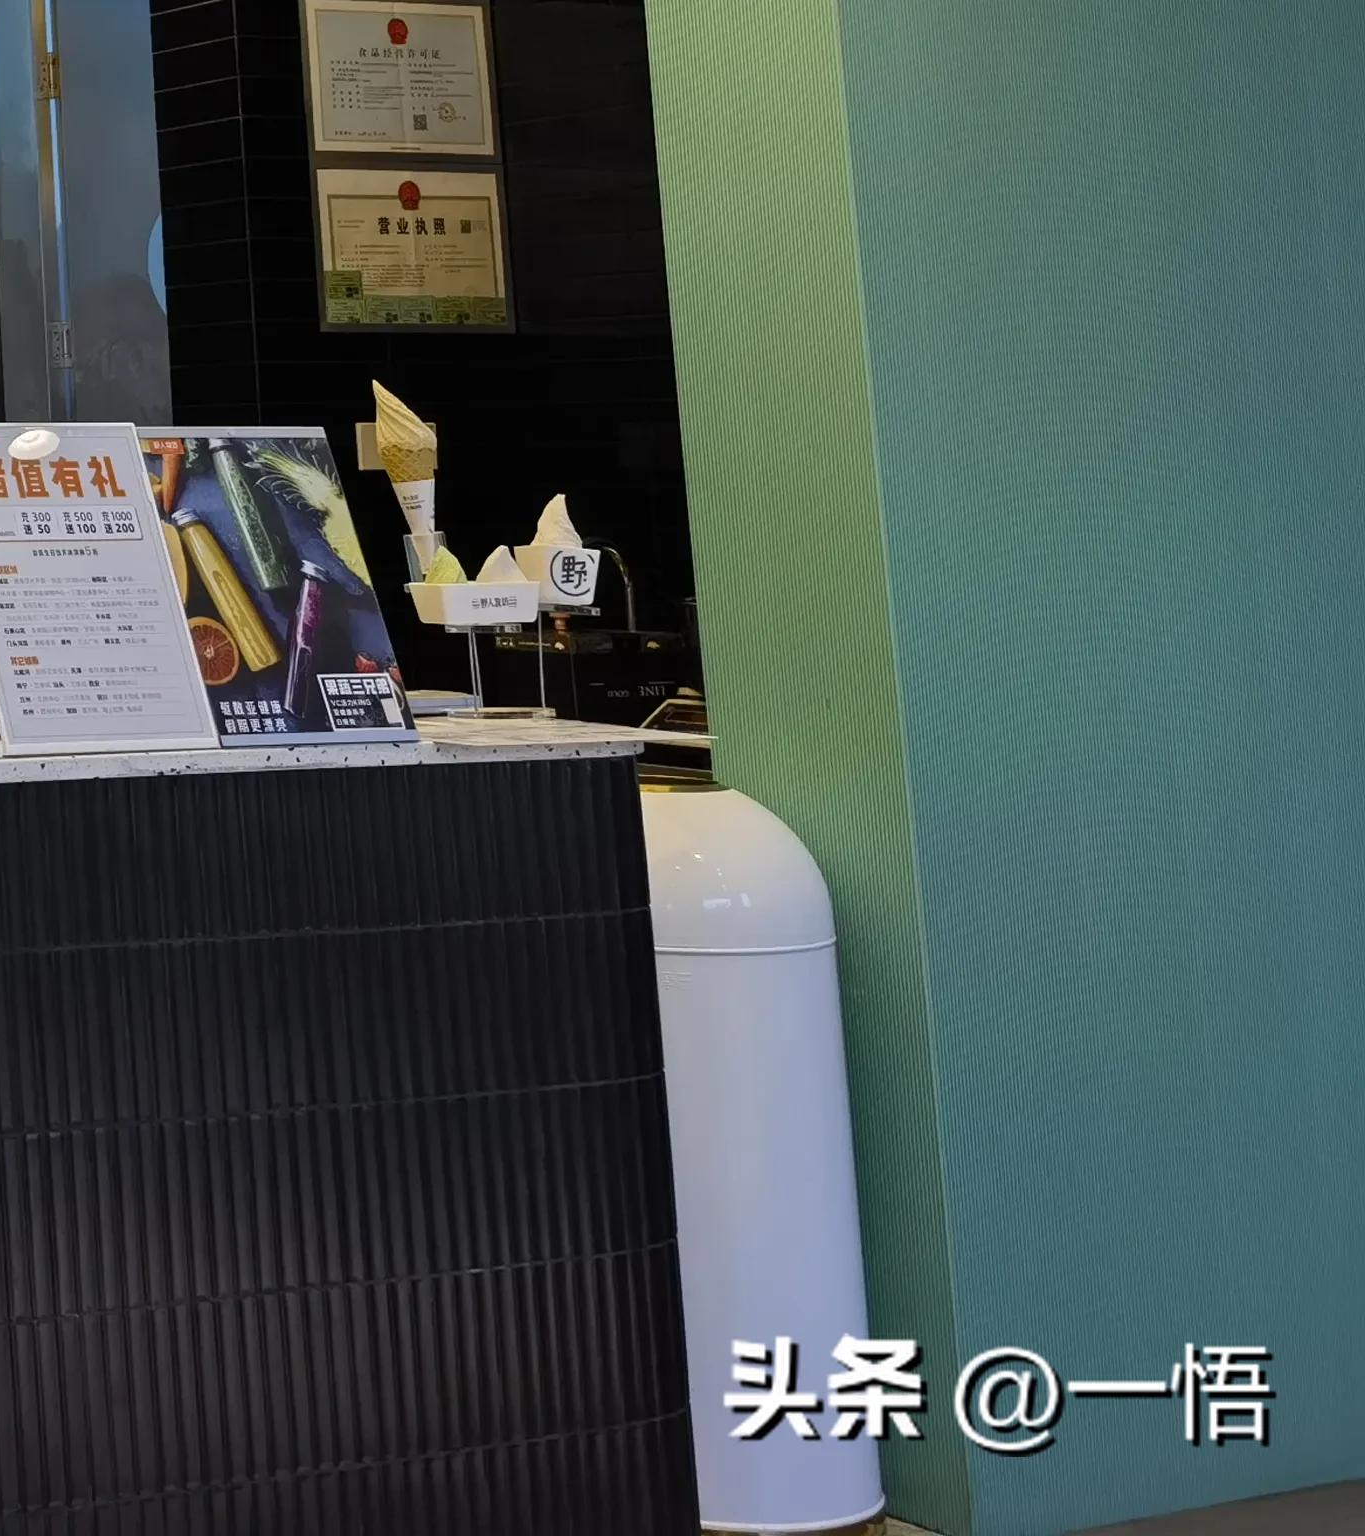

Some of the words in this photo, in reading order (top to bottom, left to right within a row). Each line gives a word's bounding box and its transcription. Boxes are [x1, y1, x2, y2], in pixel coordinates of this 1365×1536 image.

[359, 48, 440, 59] 食品经营许可证
[378, 217, 446, 235] 营业执照
[33, 512, 51, 522] 300
[75, 512, 93, 522] 500
[111, 511, 133, 521] 1000
[38, 524, 51, 534] 50
[78, 524, 97, 534] 100
[115, 523, 135, 533] 200
[561, 556, 587, 589] 野
[324, 678, 390, 695] 果蔬三兄弟
[219, 700, 283, 715] 驱散亚健康
[225, 717, 287, 733] 假期更漂亮
